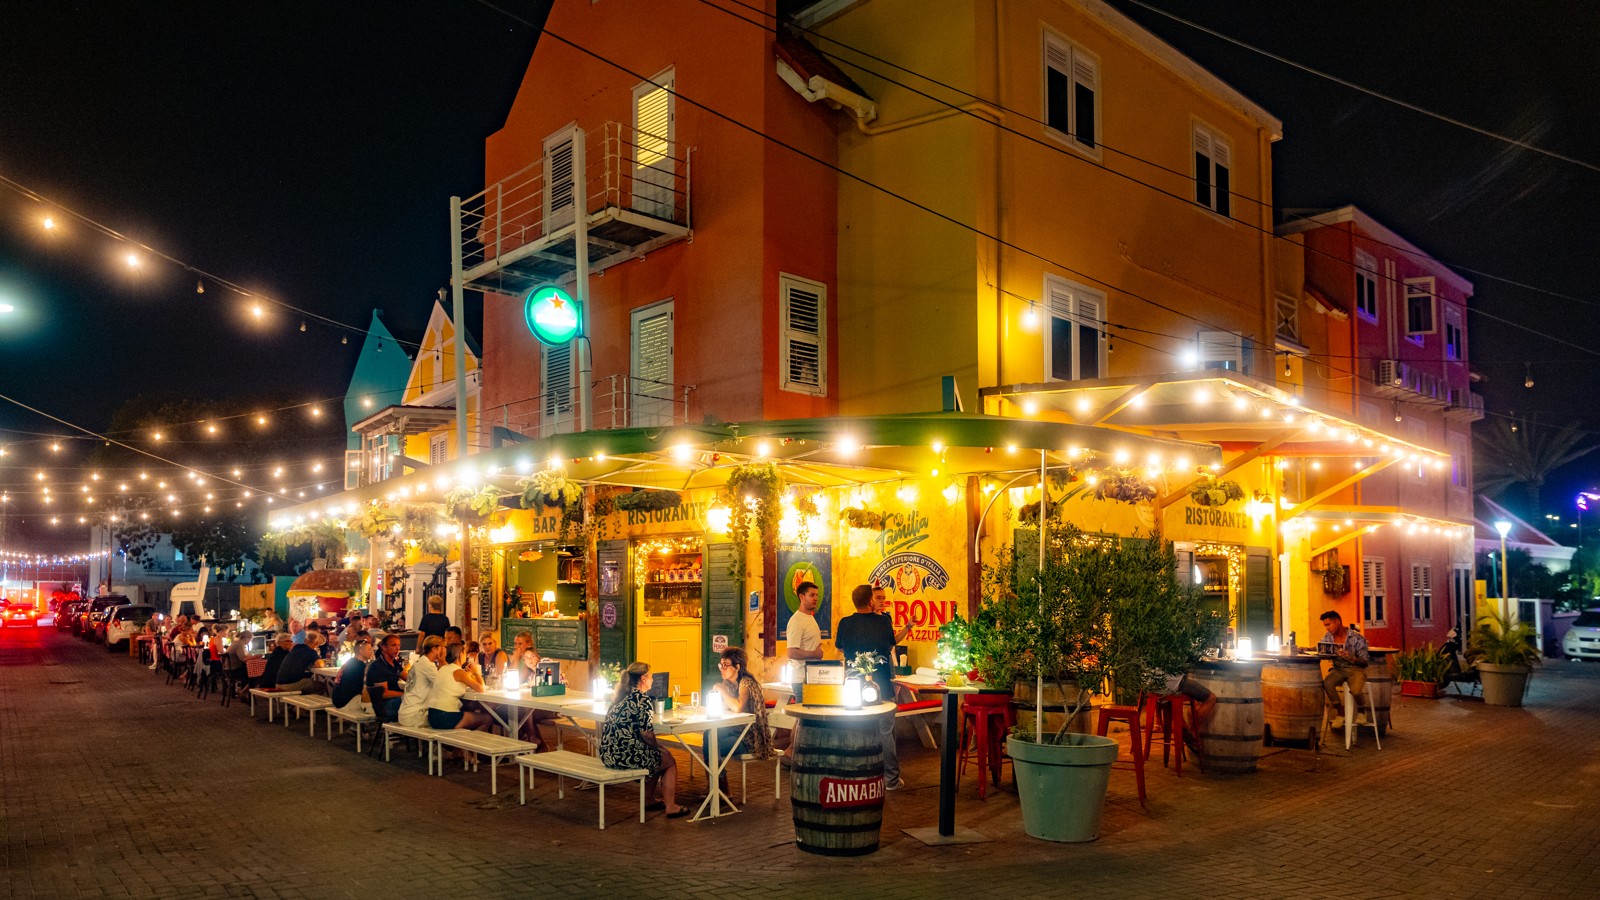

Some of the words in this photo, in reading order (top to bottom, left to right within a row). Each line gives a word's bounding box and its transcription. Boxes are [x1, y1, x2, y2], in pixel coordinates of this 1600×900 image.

[627, 502, 706, 525] RISTORANTE
[1185, 506, 1247, 529] RISTORANTE
[533, 516, 557, 534] BAR
[806, 546, 829, 554] SPRITZ
[875, 562, 891, 577] BIRRA
[890, 555, 920, 566] SUPERIORE
[880, 600, 958, 628] RONI
